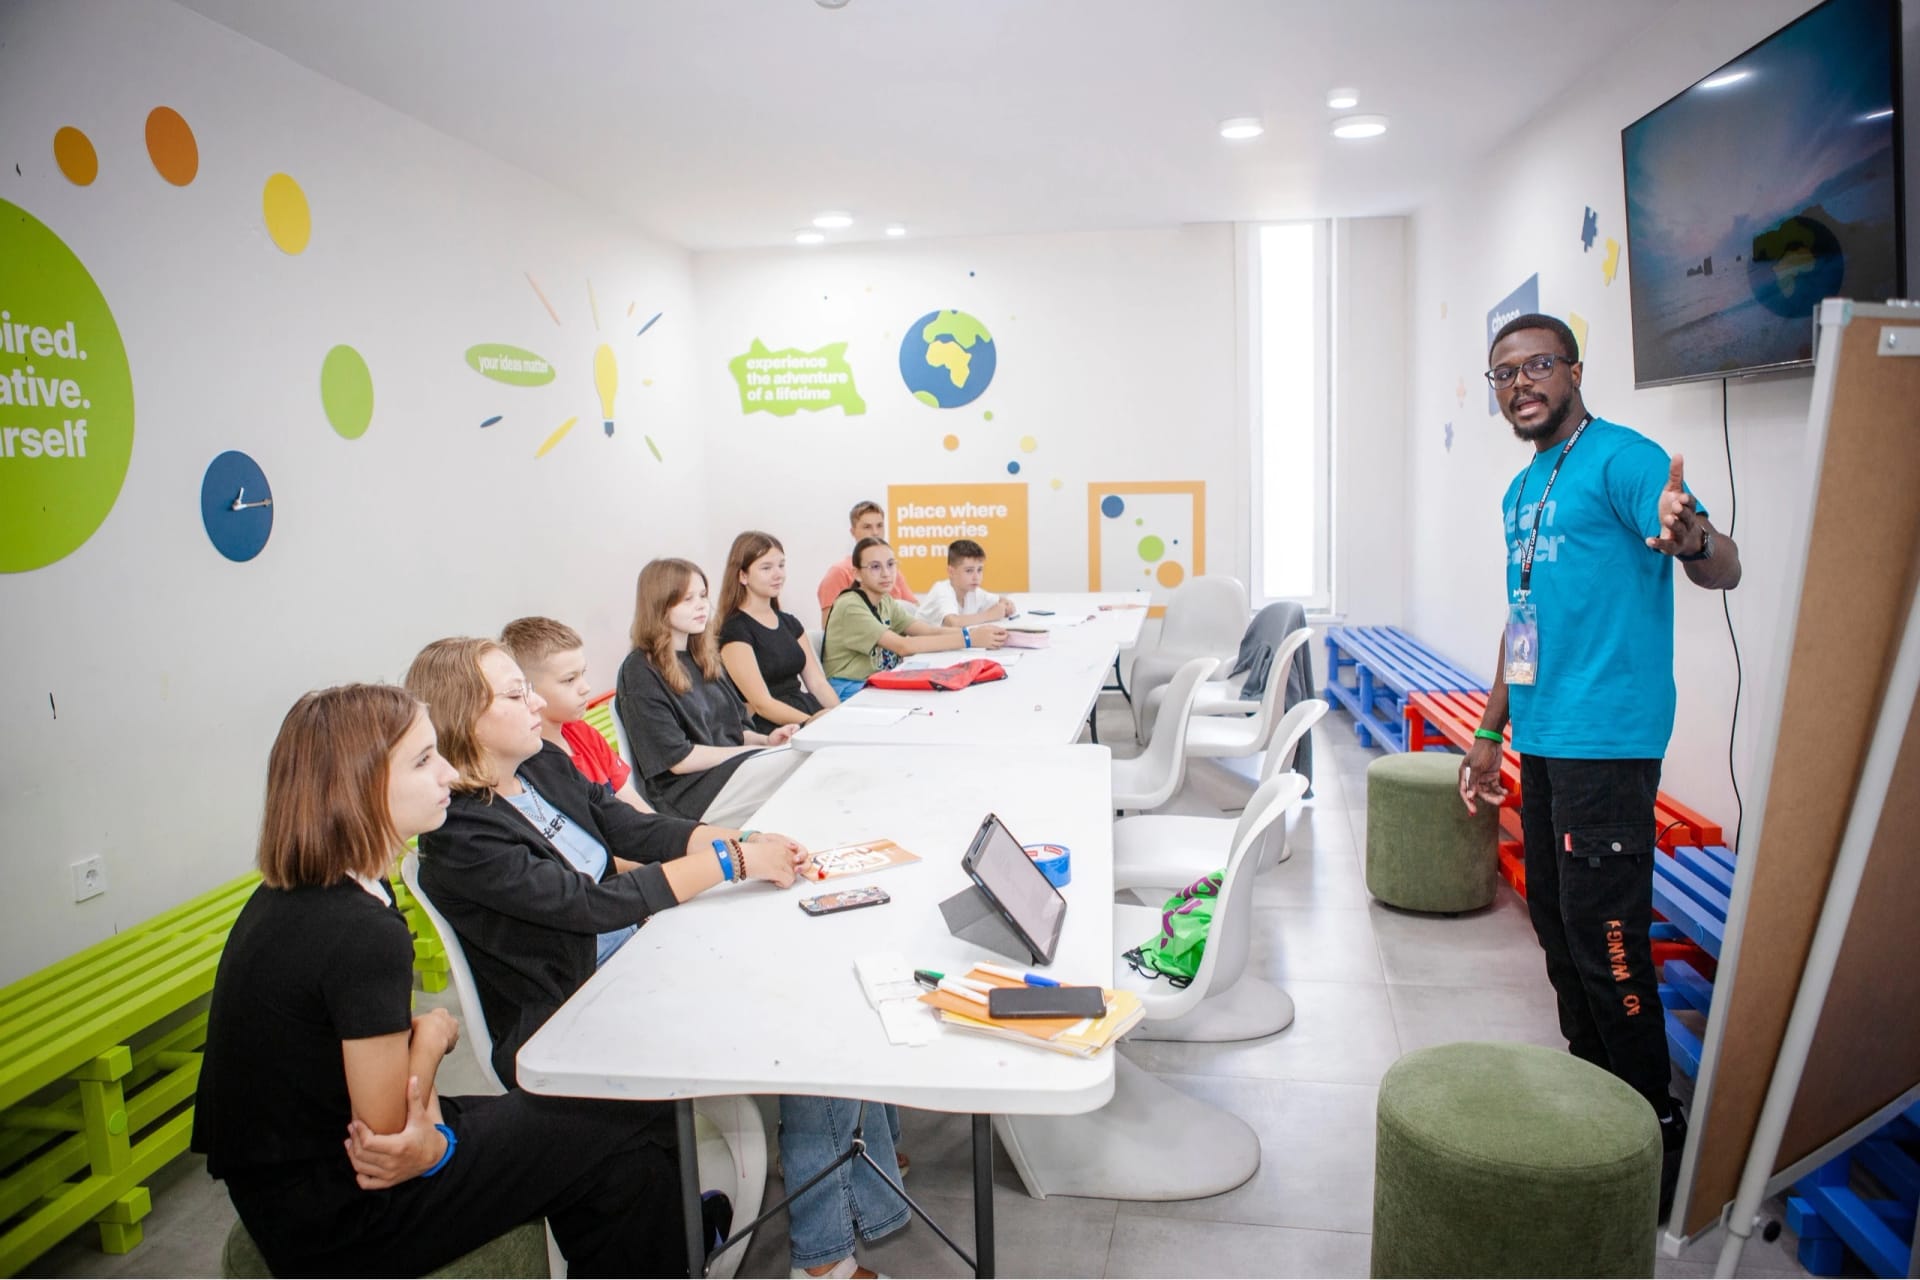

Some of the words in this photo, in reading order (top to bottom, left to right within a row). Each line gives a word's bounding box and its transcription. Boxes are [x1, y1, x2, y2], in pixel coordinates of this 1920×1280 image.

[0, 310, 87, 360] ired.
[746, 354, 828, 372] experience
[747, 372, 771, 385] the
[774, 371, 848, 385] adventure
[747, 386, 761, 400] of
[765, 390, 773, 400] a
[776, 386, 831, 400] lifetime
[897, 503, 946, 523] place
[950, 502, 1008, 518] where
[897, 521, 988, 538] memories
[898, 544, 927, 558] are
